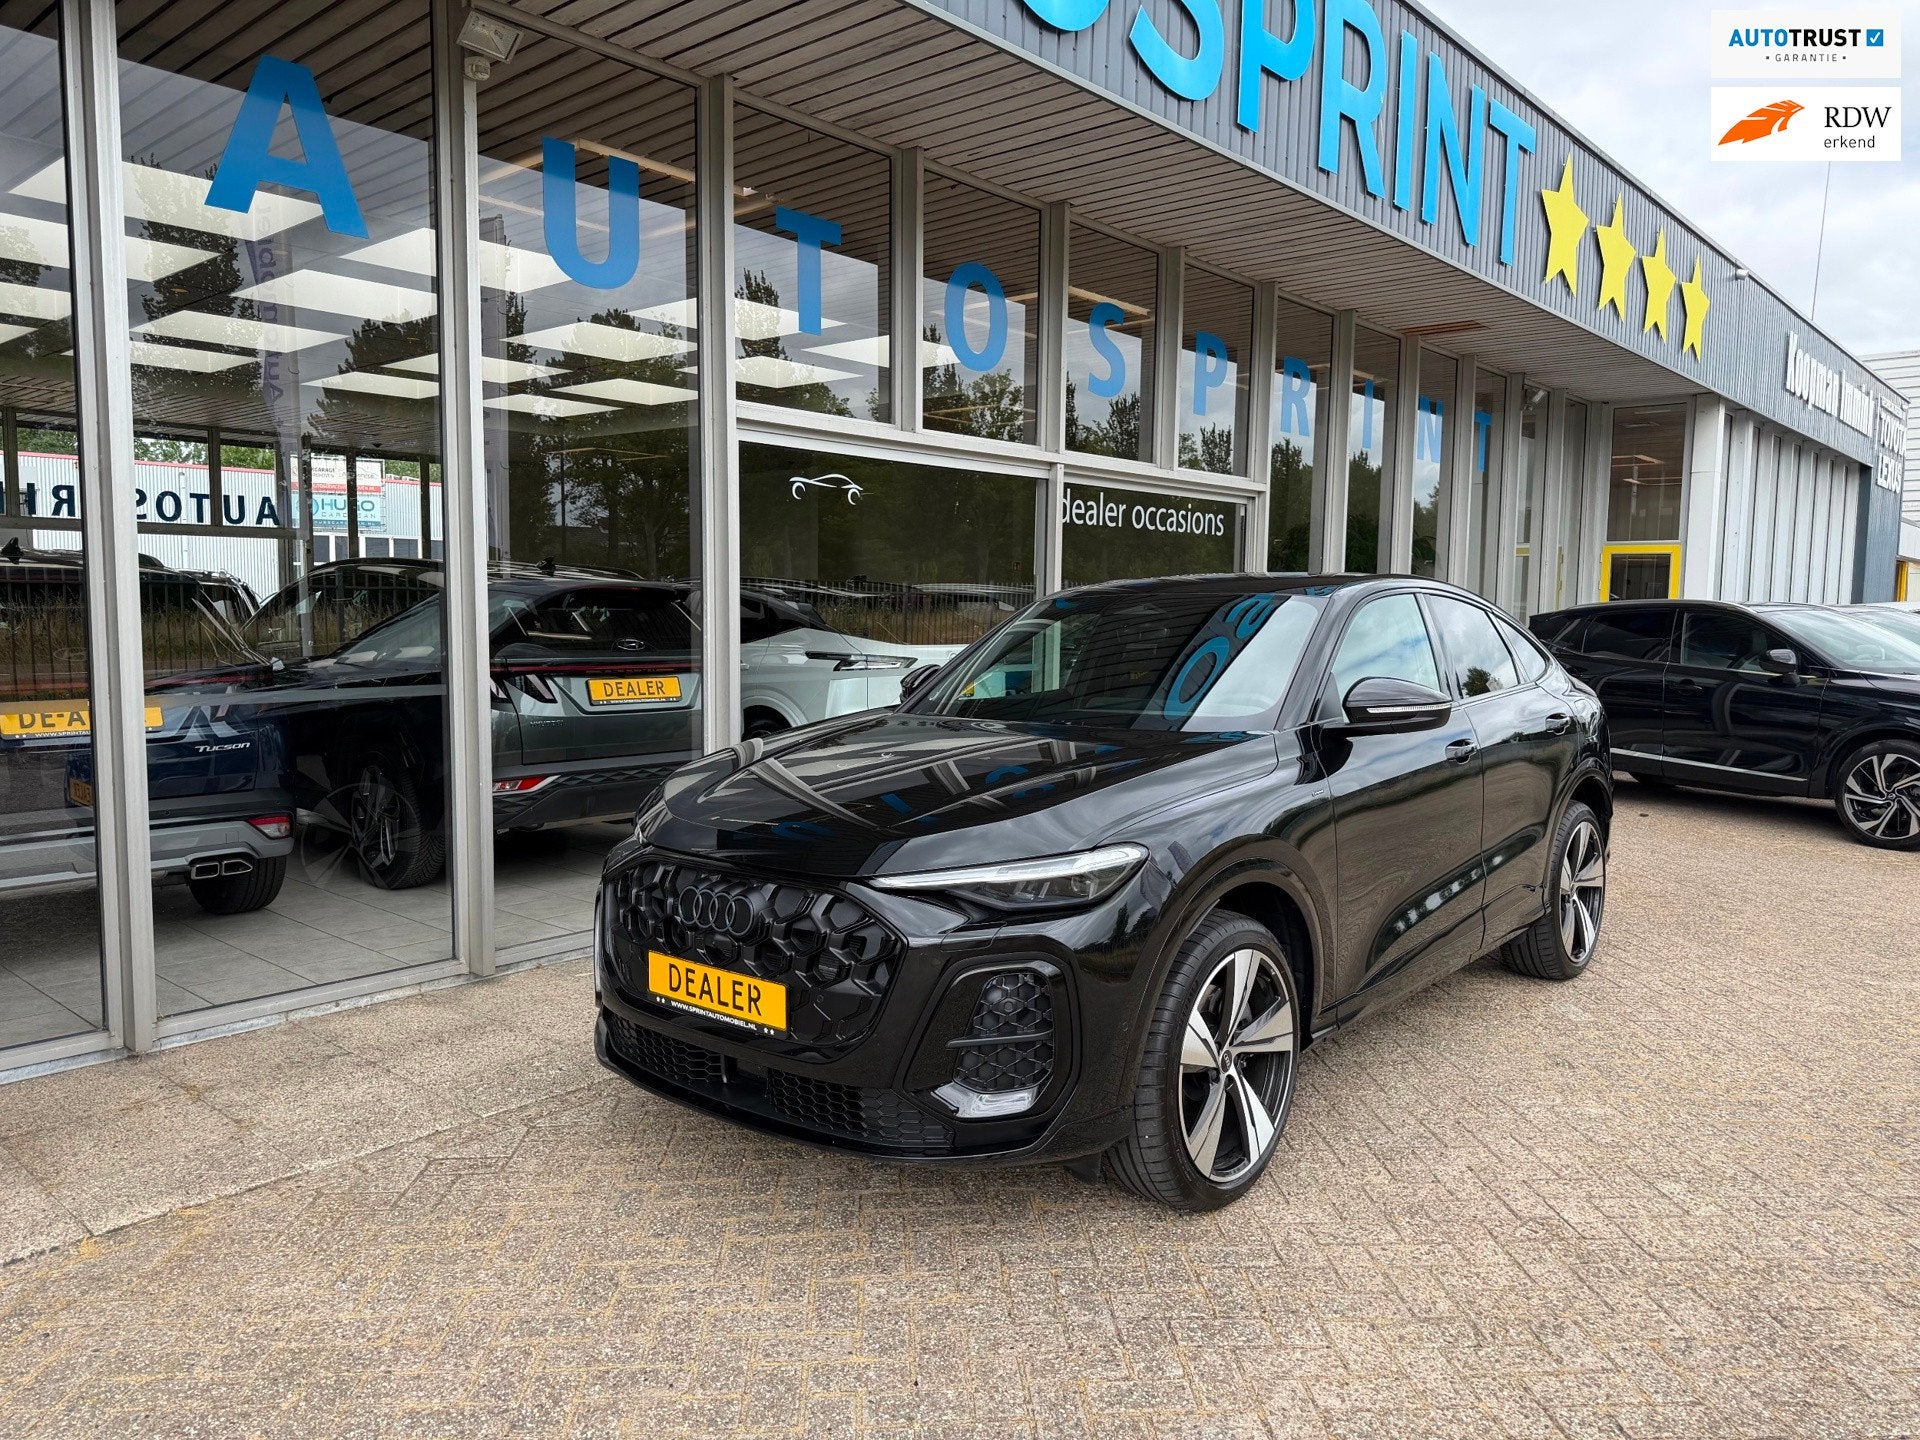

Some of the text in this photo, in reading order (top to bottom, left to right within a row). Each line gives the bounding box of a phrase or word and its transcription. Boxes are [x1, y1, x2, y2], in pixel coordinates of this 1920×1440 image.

[1877, 453, 1901, 494] LEXUS
[1062, 488, 1225, 536] dealer occasions
[603, 680, 666, 697] DEALER
[668, 963, 762, 1016] DEALER
[671, 1000, 757, 1031] WWW.SPRINTAUTOMOBIEL.NL
